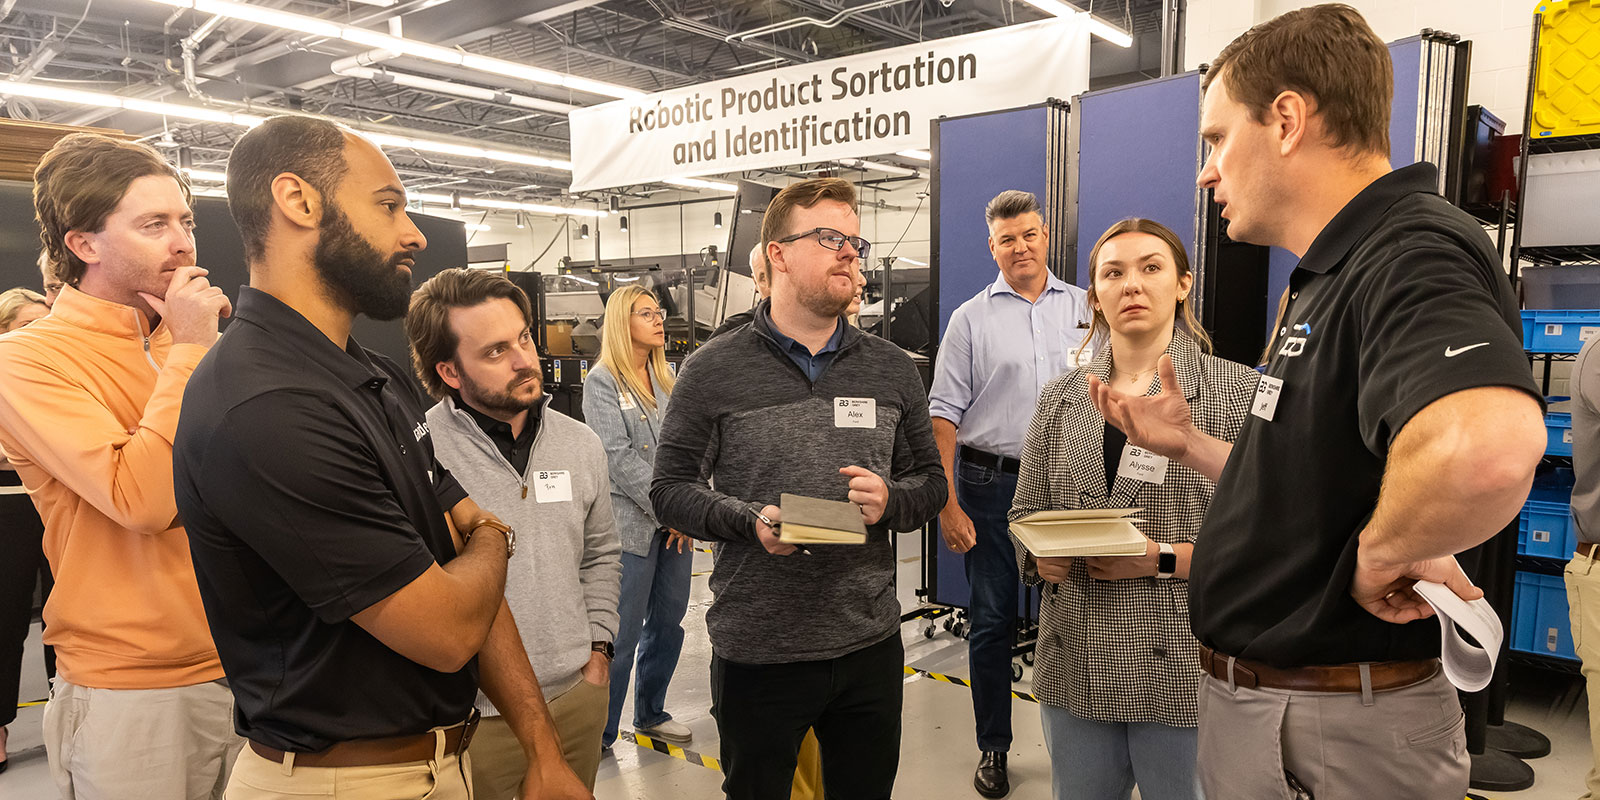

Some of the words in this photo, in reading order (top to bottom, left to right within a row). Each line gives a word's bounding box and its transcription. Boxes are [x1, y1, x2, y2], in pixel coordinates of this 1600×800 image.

[629, 93, 713, 134] Robotic
[721, 74, 822, 118] Product
[831, 51, 977, 101] Sortation
[673, 130, 716, 165] and
[725, 107, 911, 158] Identification
